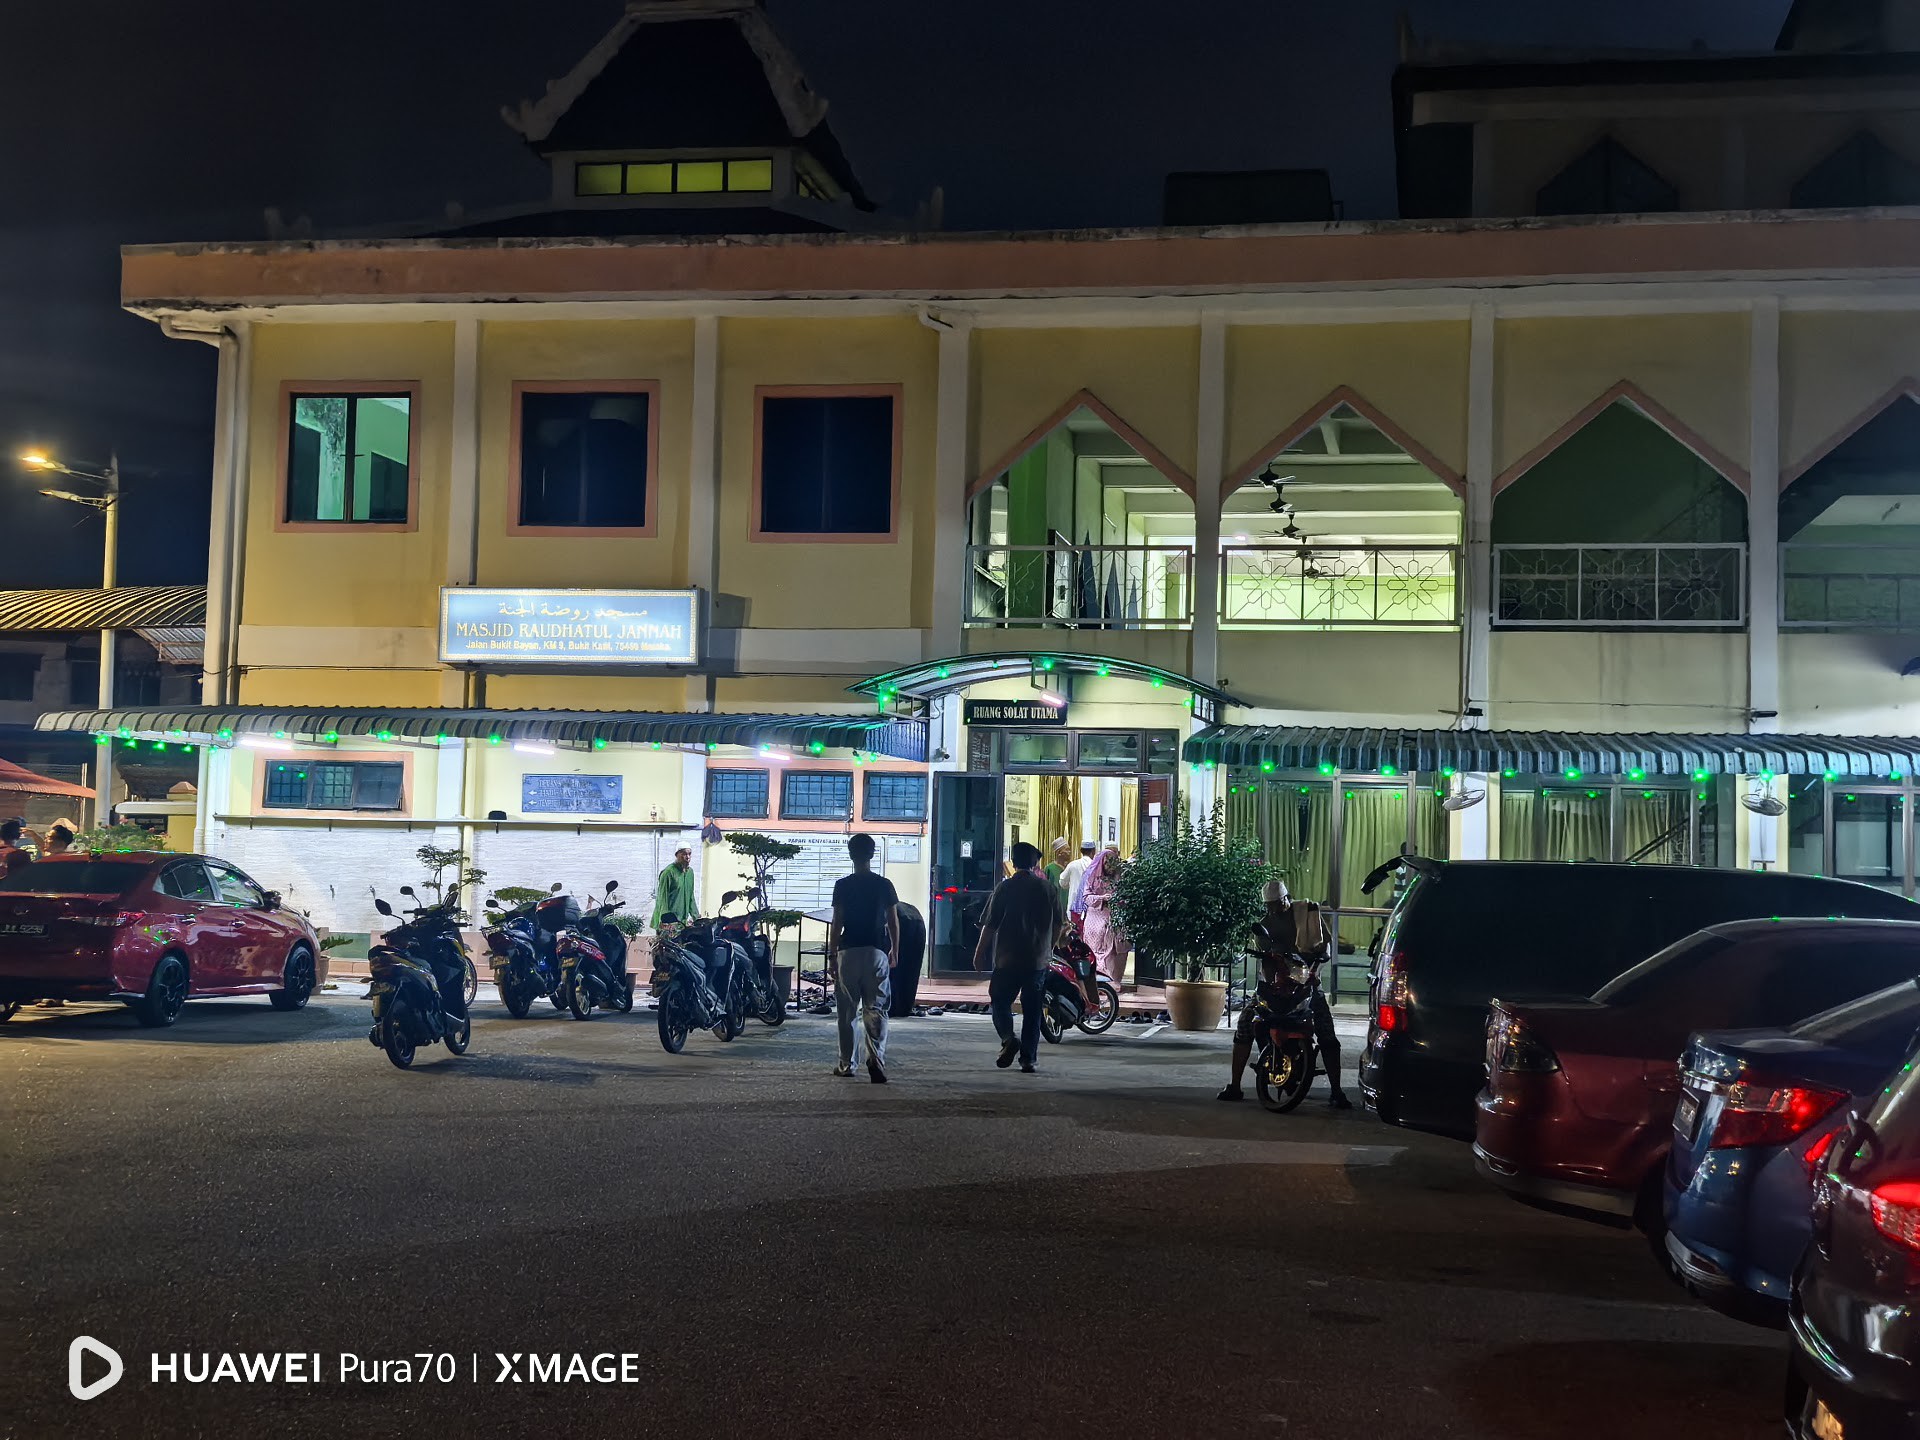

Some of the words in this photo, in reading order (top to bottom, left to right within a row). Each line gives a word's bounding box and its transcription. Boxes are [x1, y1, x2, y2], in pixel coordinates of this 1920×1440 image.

[498, 598, 535, 617] الجنة
[541, 602, 590, 621] روضة
[595, 606, 648, 618] مسجد
[456, 623, 514, 637] MASJID
[519, 623, 612, 638] RAUDHATUL
[617, 624, 682, 639] JANNAH
[465, 640, 488, 650] Jalan
[490, 640, 512, 650] Bukit
[973, 706, 1001, 719] RUANG
[1003, 706, 1029, 719] SOLAT
[1031, 707, 1059, 719] UTAMA
